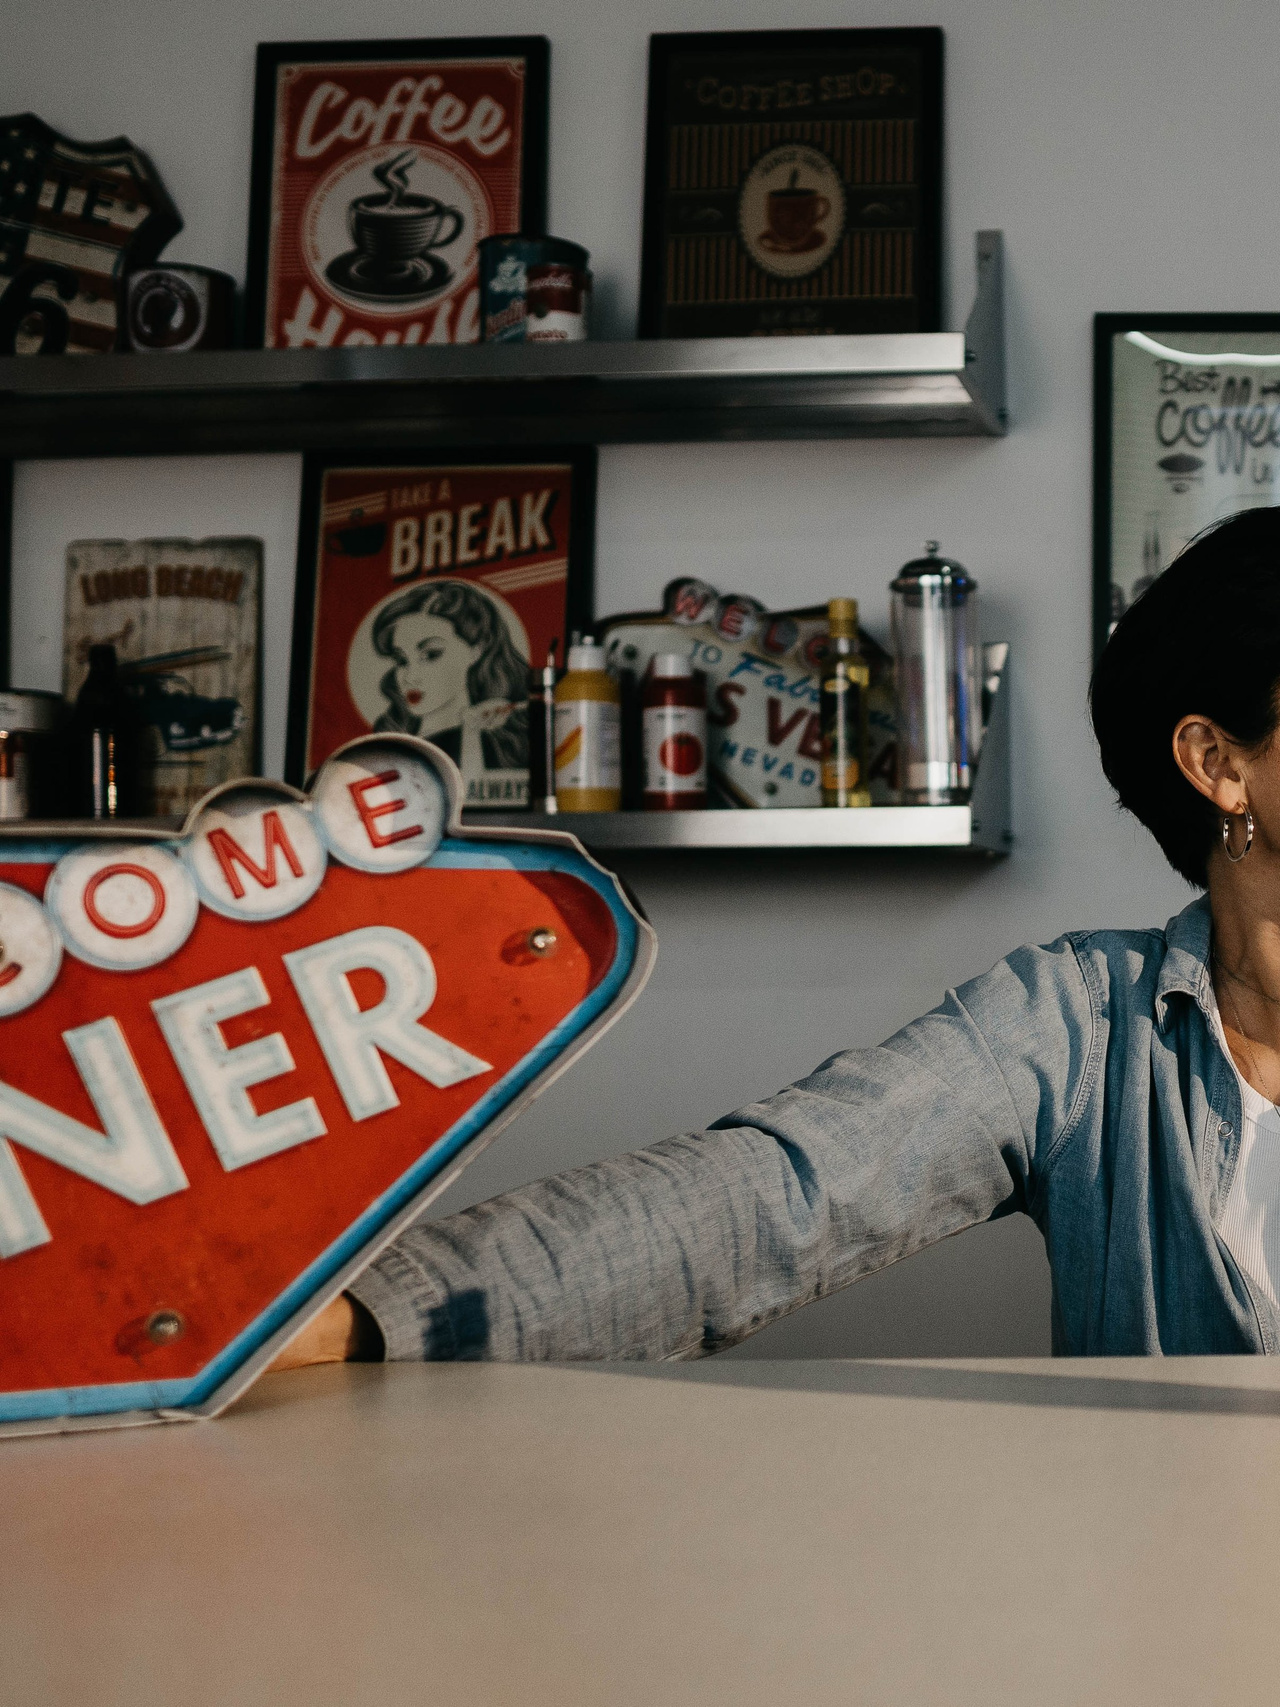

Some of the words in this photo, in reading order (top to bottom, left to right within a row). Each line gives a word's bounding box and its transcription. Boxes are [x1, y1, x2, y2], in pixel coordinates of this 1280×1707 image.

[696, 75, 814, 112] COFFEE
[820, 66, 896, 101] SHOP
[296, 74, 511, 159] Coffee
[438, 477, 452, 500] A
[390, 488, 556, 579] BREAK
[78, 564, 151, 608] LONG
[154, 564, 244, 605] BEACH
[721, 739, 820, 788] NEVAD
